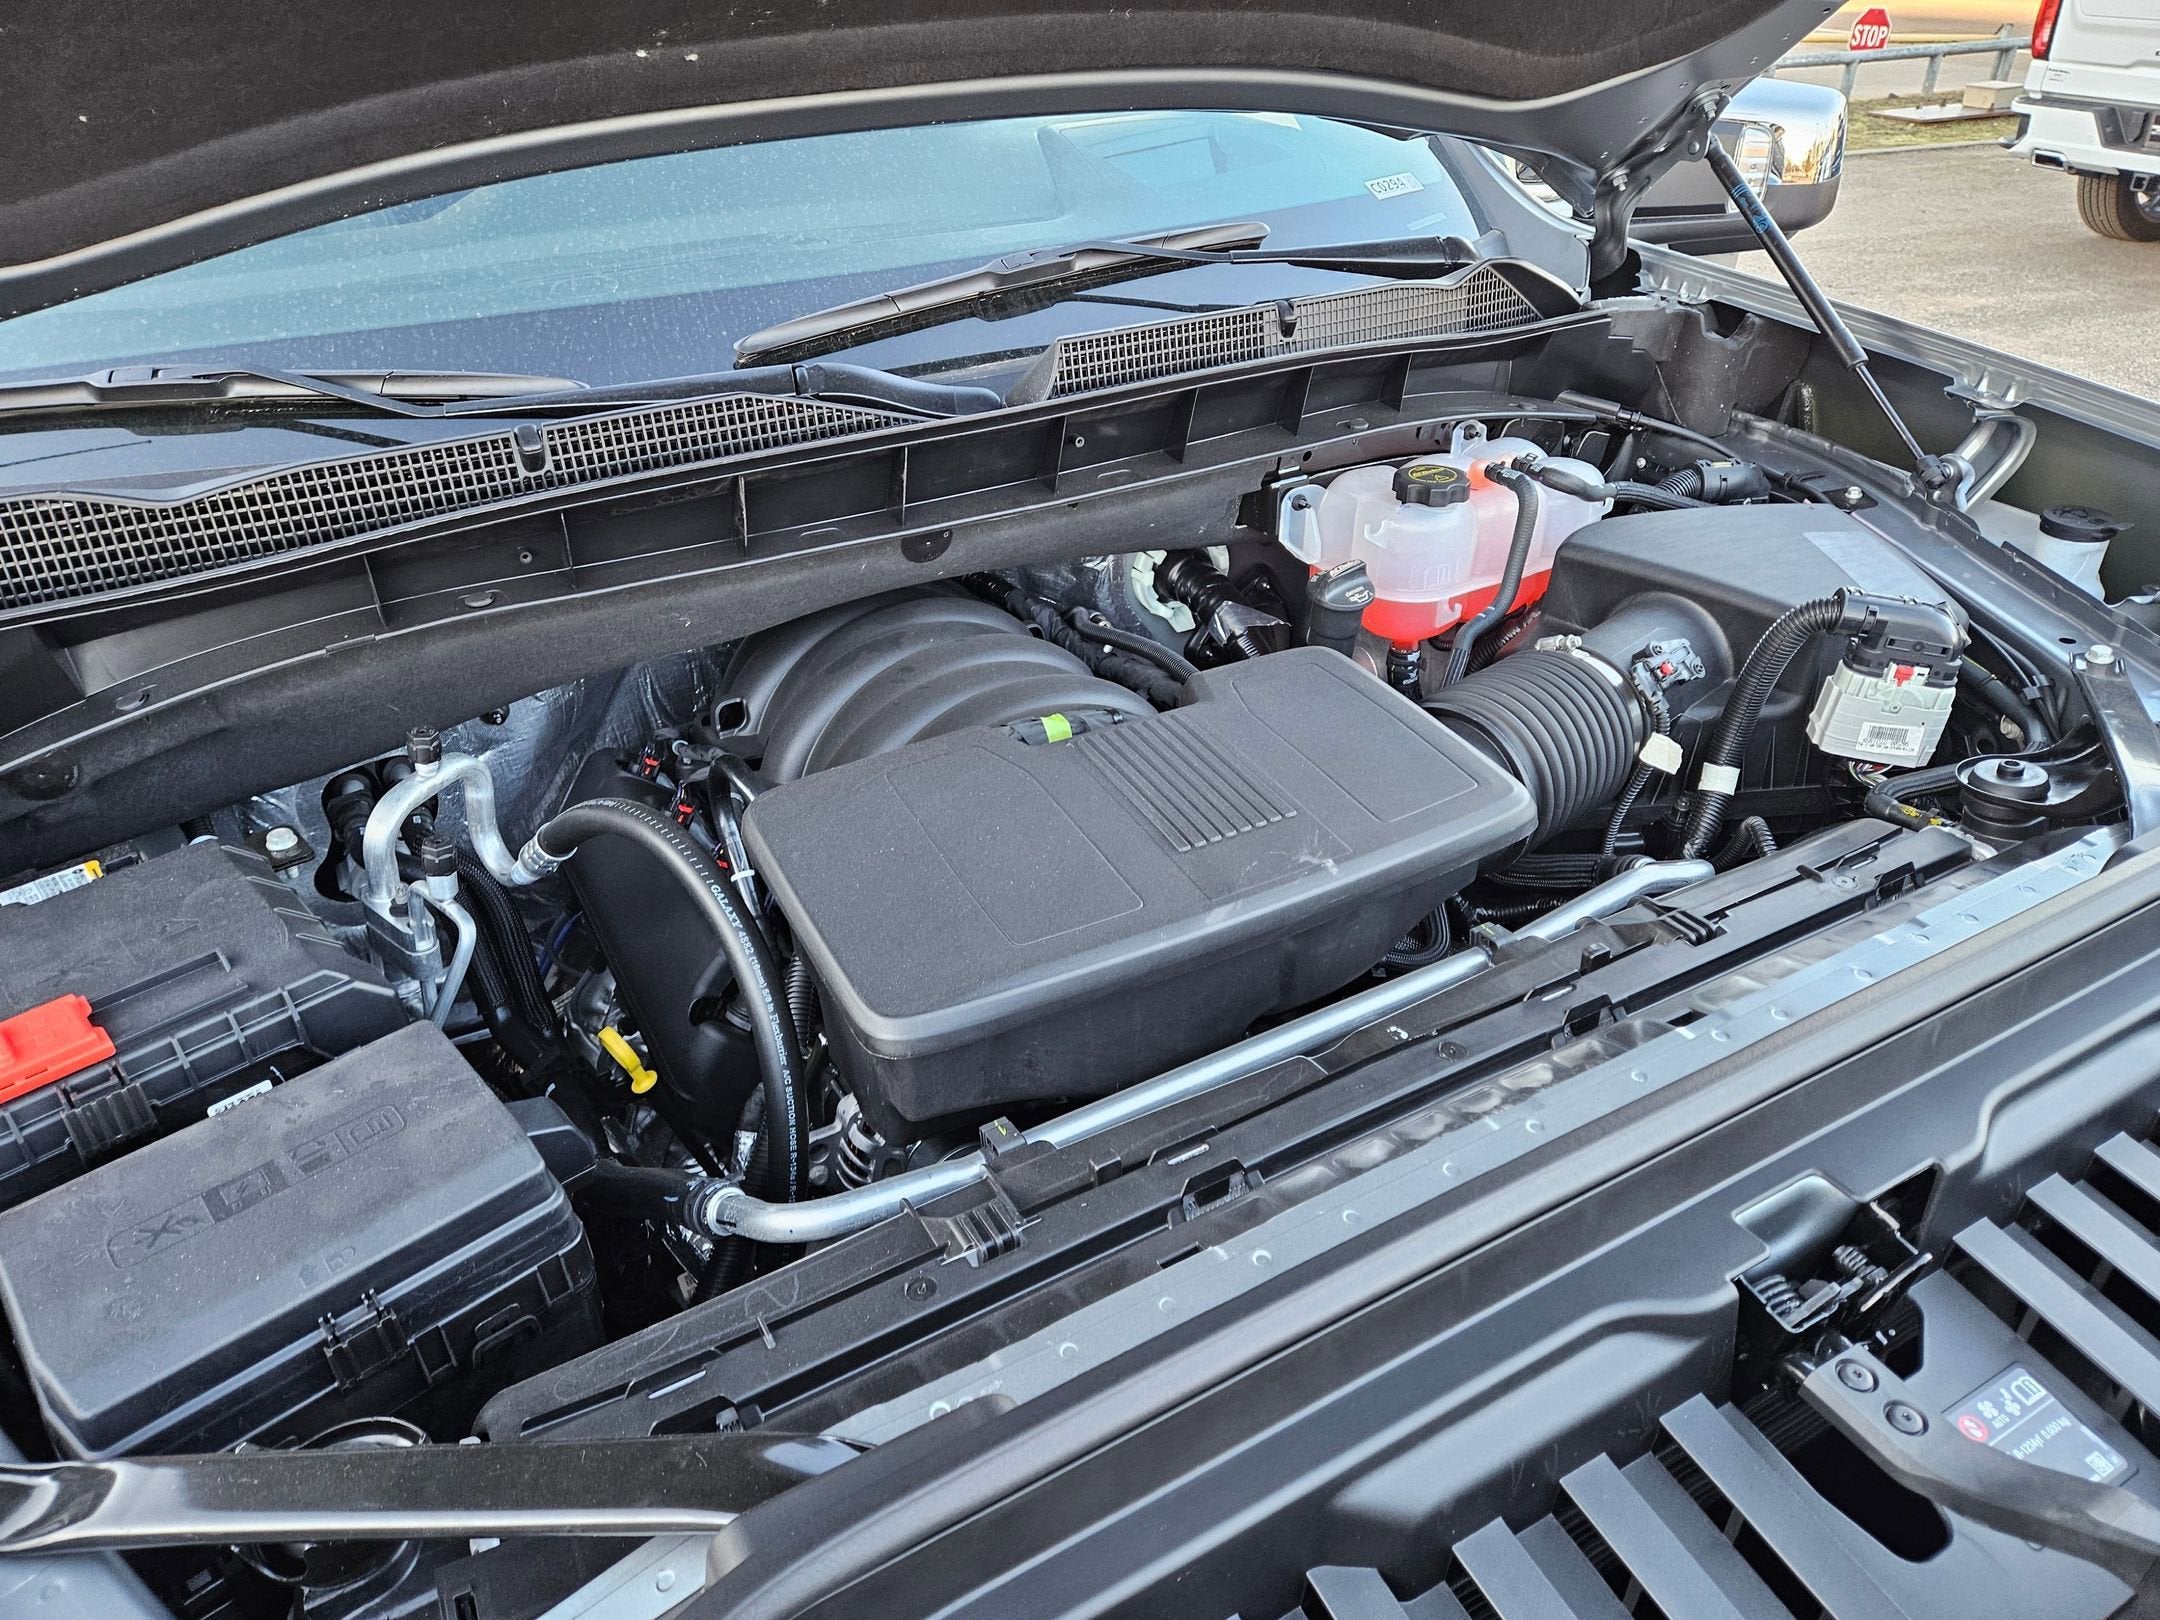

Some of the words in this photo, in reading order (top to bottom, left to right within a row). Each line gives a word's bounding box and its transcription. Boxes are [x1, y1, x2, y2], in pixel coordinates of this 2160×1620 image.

[1851, 24, 1889, 48] STOP
[711, 884, 743, 929] GALAXY
[738, 930, 754, 956] 4882
[769, 1013, 788, 1067] Flexbarrier
[785, 1086, 797, 1126] SUCTION
[789, 1127, 798, 1151] HOSE
